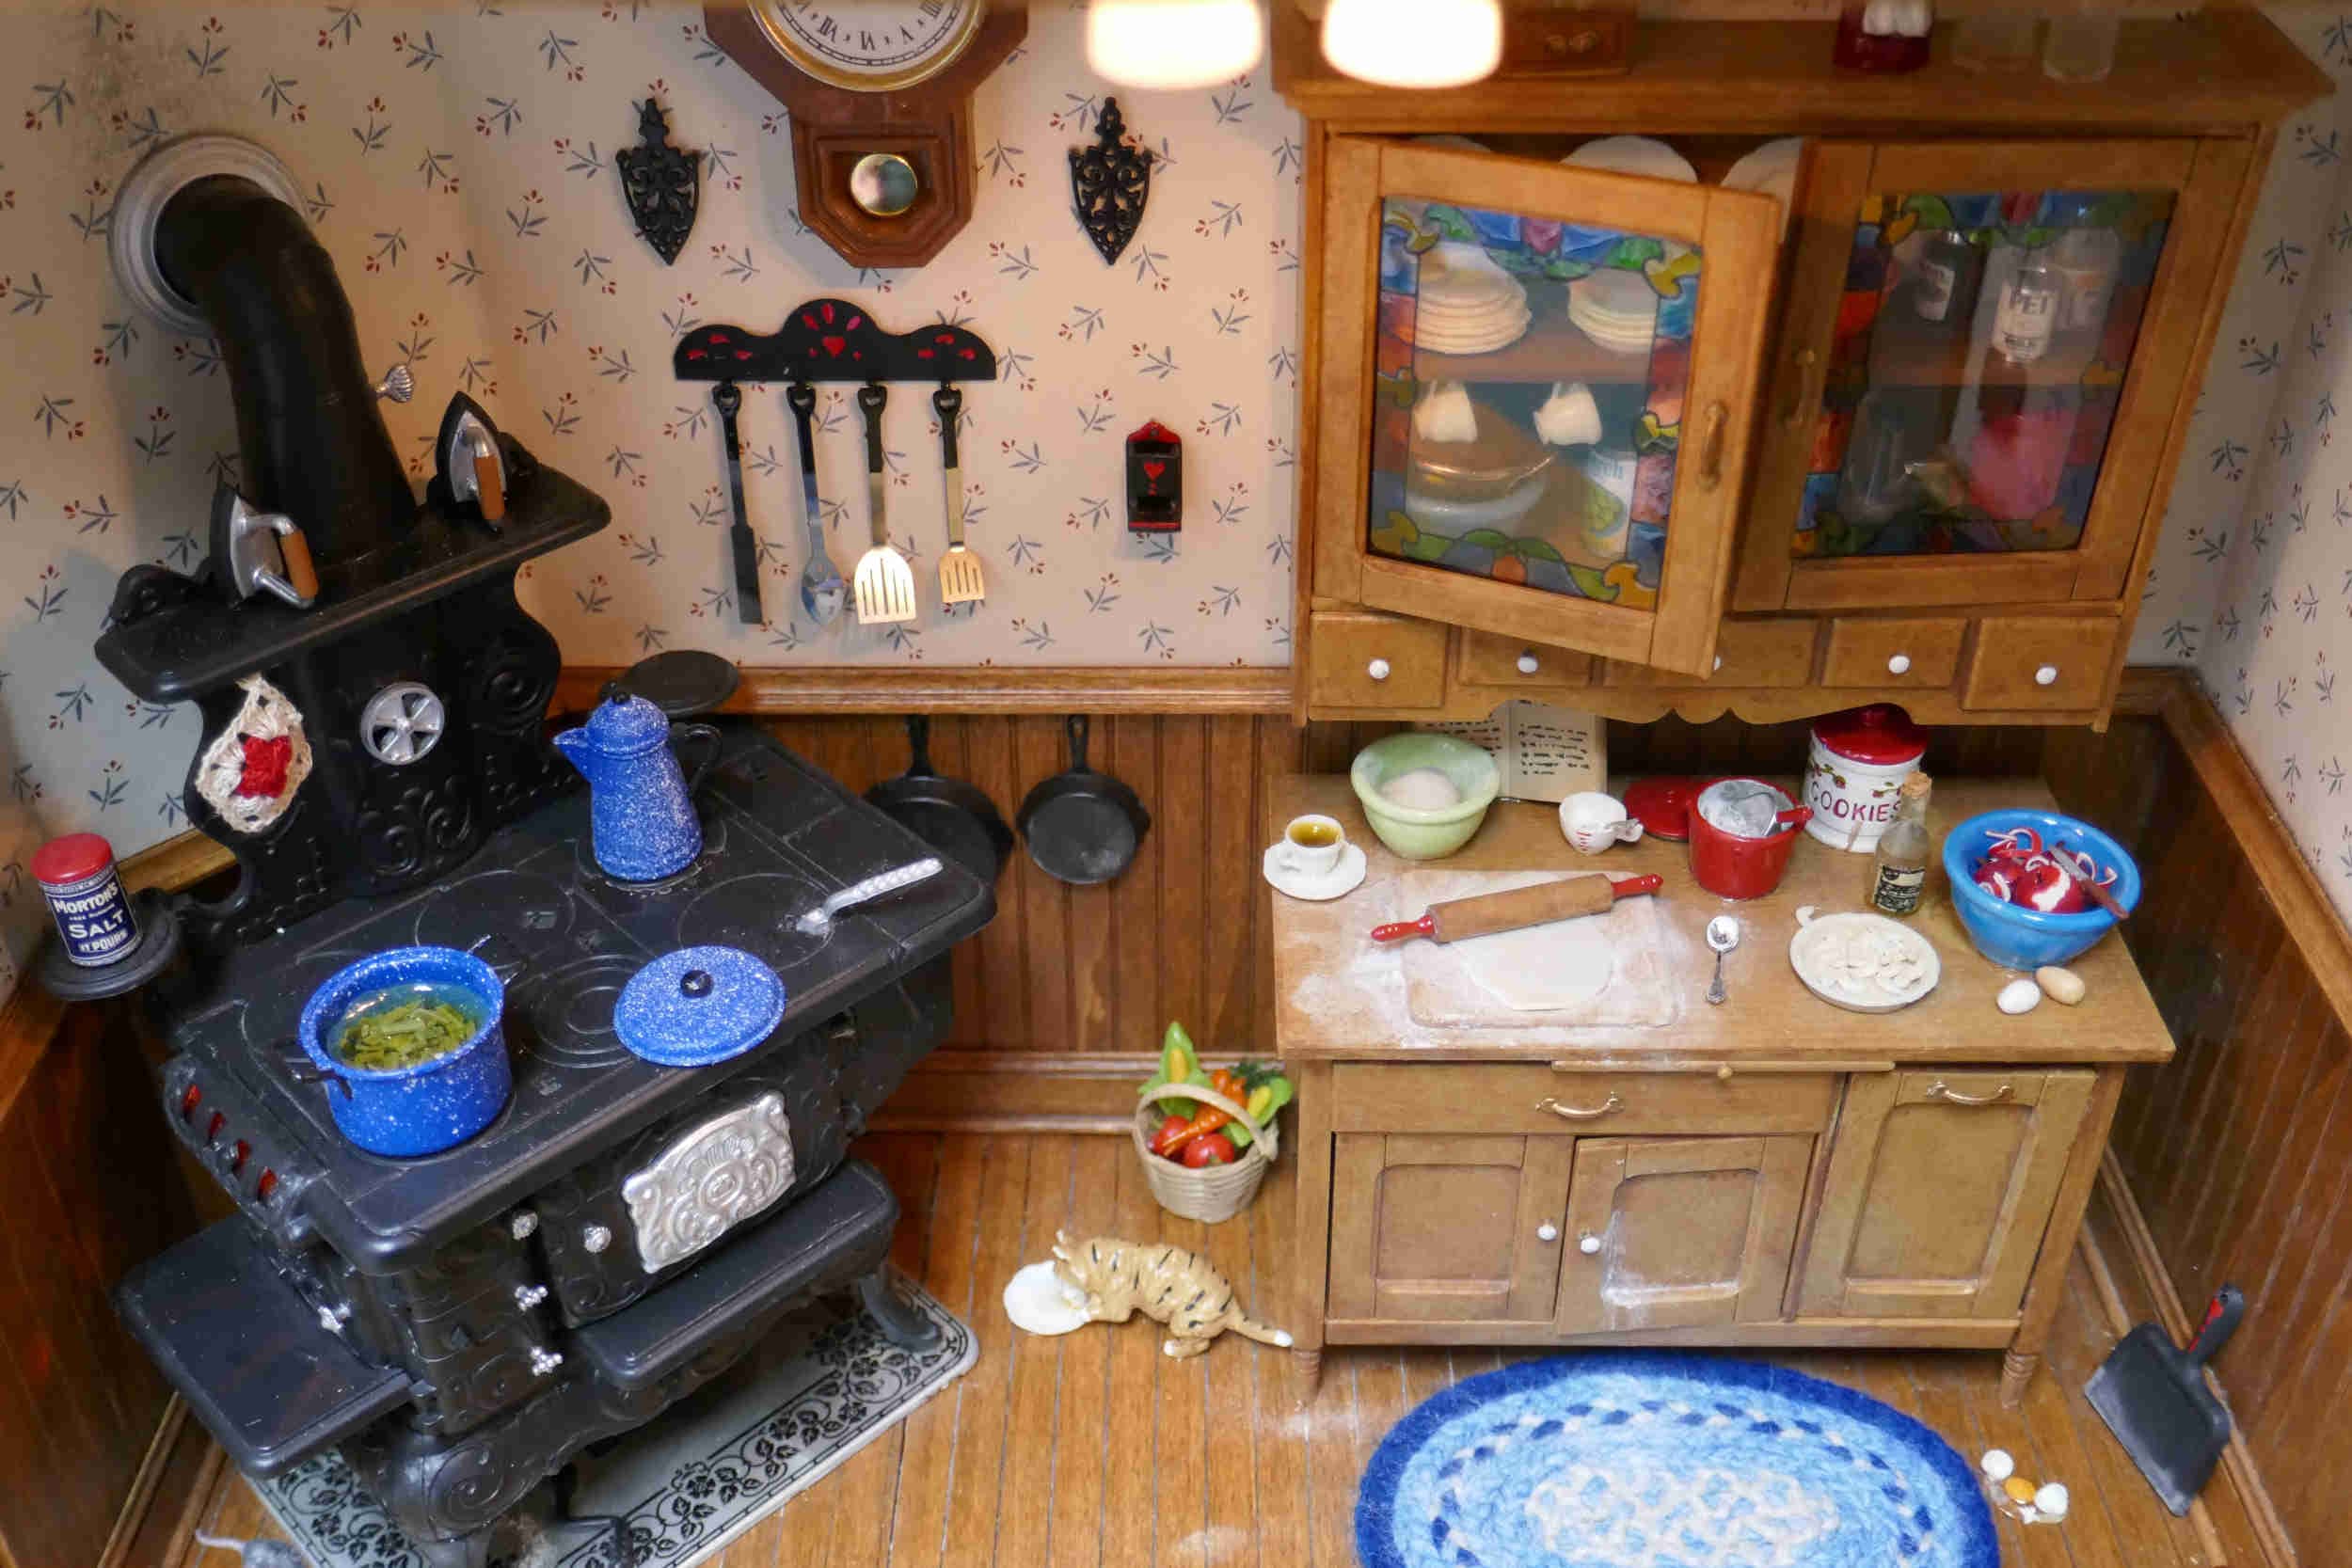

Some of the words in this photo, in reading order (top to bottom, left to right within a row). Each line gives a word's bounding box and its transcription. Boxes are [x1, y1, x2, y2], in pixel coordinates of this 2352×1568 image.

[861, 30, 876, 51] VI
[1811, 781, 1901, 822] COOKIES
[68, 910, 123, 939] SALT
